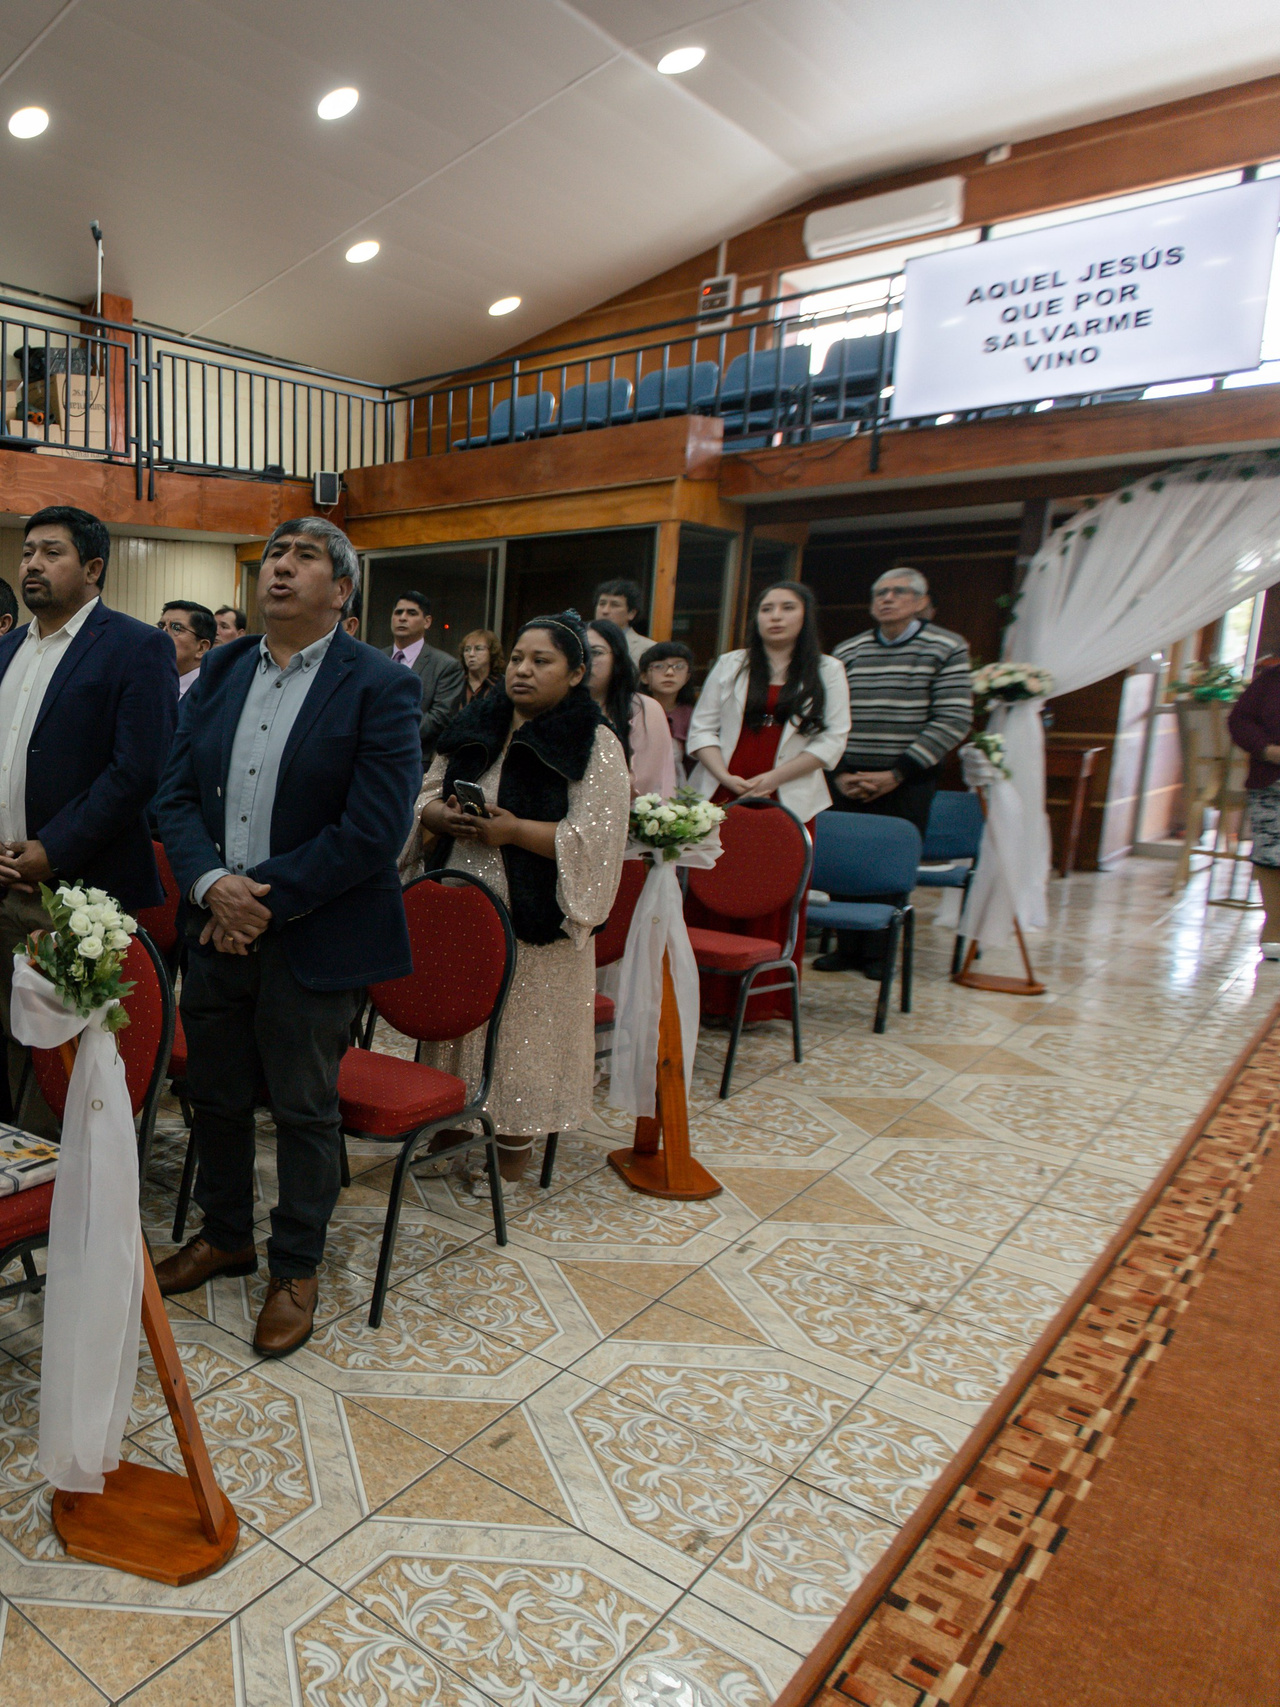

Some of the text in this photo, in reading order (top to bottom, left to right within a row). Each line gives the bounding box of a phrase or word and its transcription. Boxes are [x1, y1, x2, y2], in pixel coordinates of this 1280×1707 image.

[967, 246, 1185, 305] AQUEL JESÚS
[1000, 283, 1139, 323] QUE POR
[982, 308, 1153, 353] SALVARME
[1023, 345, 1101, 372] VINO
